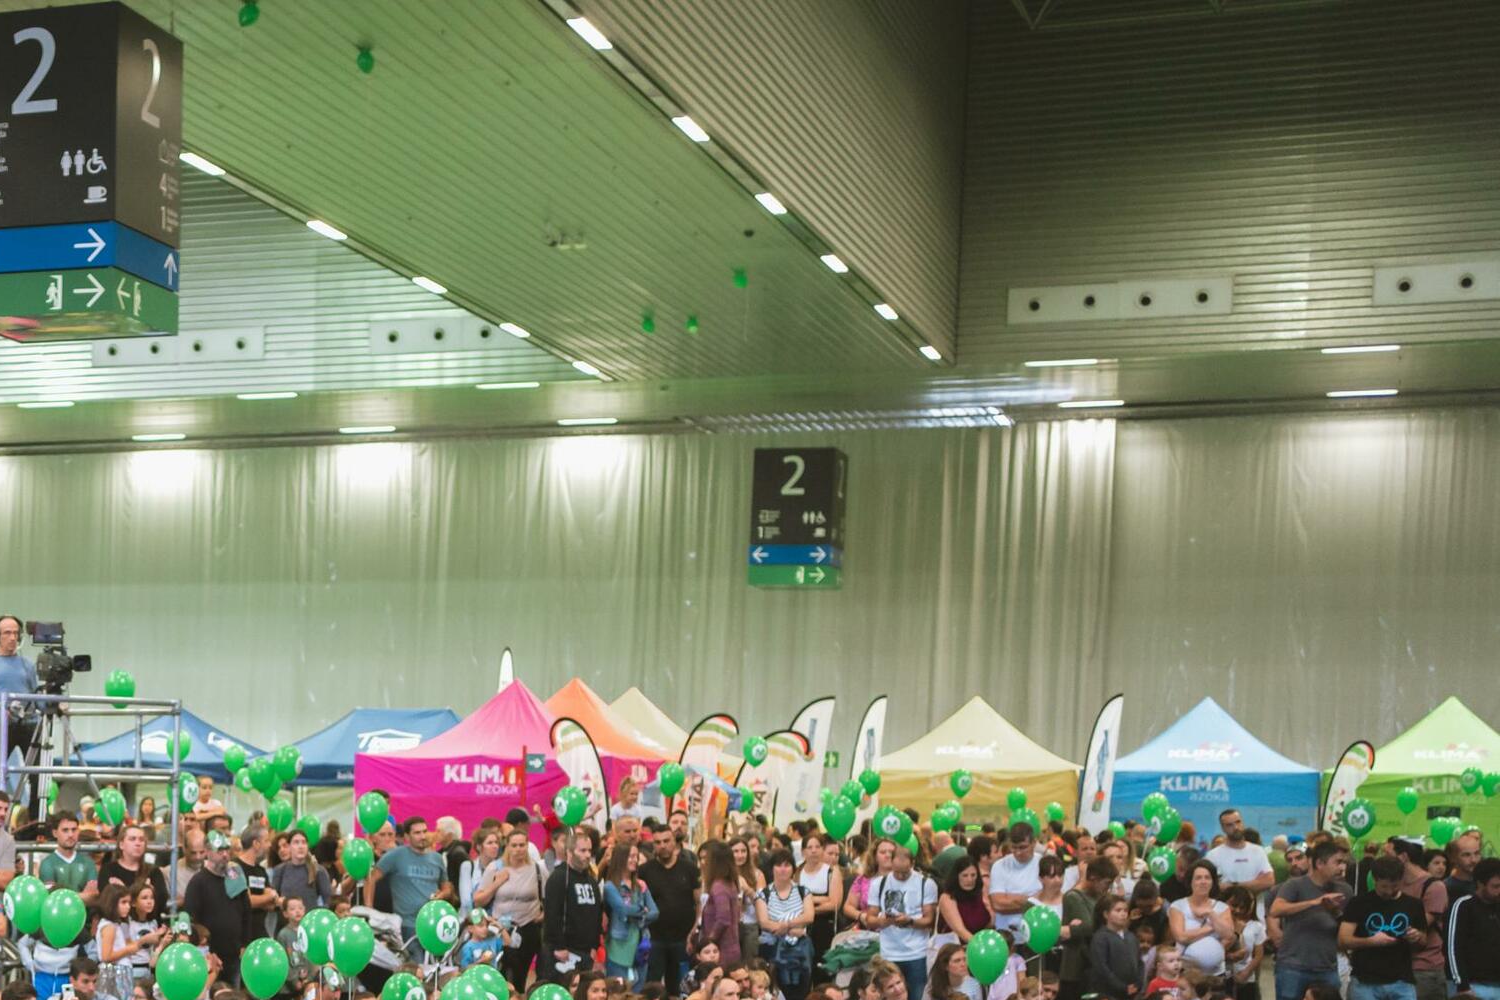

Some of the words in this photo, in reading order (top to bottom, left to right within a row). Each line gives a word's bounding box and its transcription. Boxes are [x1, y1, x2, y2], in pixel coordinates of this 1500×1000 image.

[11, 27, 58, 115] 2
[141, 38, 160, 128] 2
[780, 455, 805, 495] 2
[444, 764, 504, 784] KLIM
[1160, 776, 1229, 791] KLIMA
